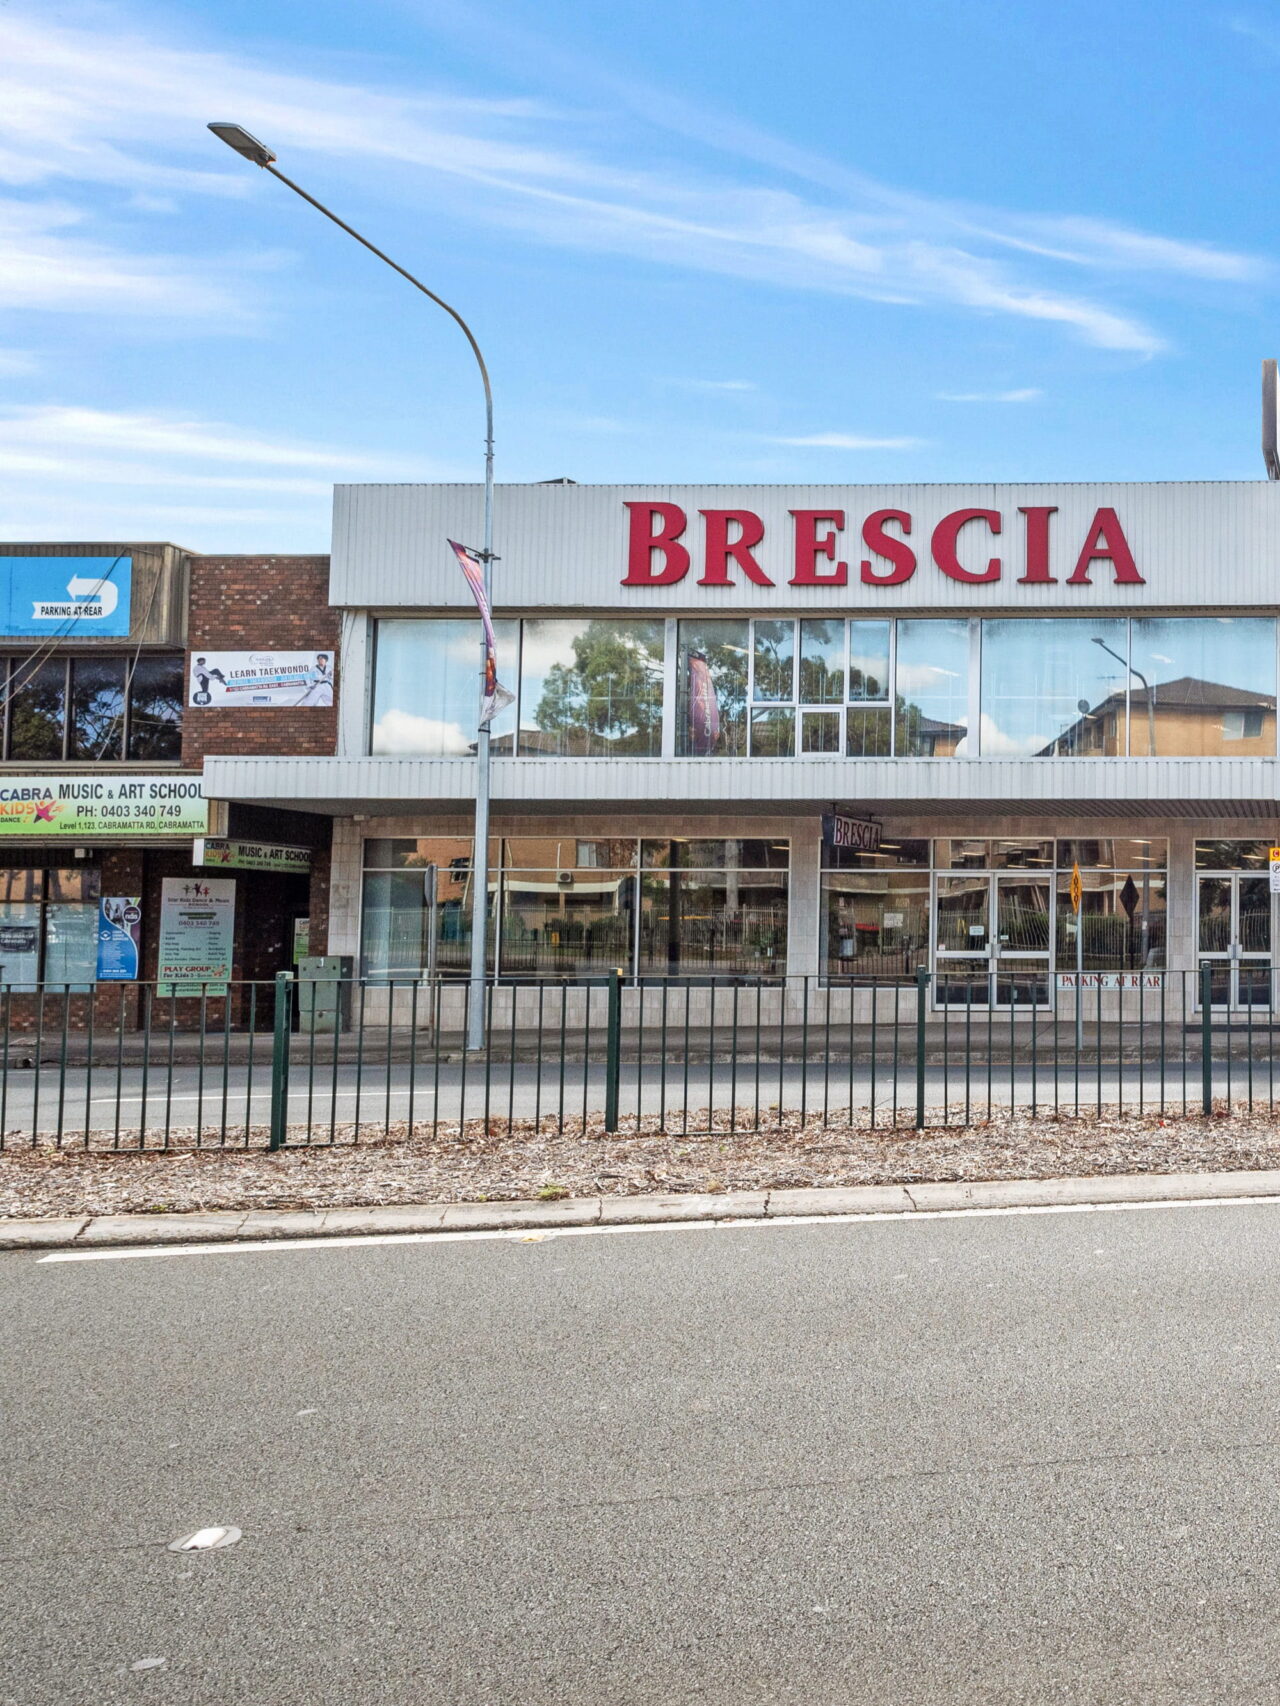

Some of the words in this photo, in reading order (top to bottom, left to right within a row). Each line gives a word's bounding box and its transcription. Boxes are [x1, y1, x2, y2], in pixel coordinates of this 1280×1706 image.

[620, 501, 1146, 586] BRESCIA
[41, 606, 71, 616] PARKING
[73, 606, 82, 616] AT
[84, 606, 103, 616] REAR
[230, 669, 257, 678] LEARN
[259, 665, 309, 676] TAEKWONDO
[0, 787, 53, 801] CABRA
[58, 784, 103, 799] MUSIC
[107, 790, 114, 799] &
[118, 784, 145, 799] ART
[0, 802, 35, 815] KIDS
[77, 805, 97, 817] PH:
[101, 805, 130, 817] 0403
[134, 805, 156, 817] 340
[160, 805, 182, 817] 749
[98, 821, 144, 829] CABRAMATTA
[158, 820, 205, 829] CABRAMATTA
[835, 818, 880, 850] BRESCIA
[238, 845, 262, 858] MUSIC
[269, 849, 284, 860] ART
[1062, 975, 1109, 986] PAKING
